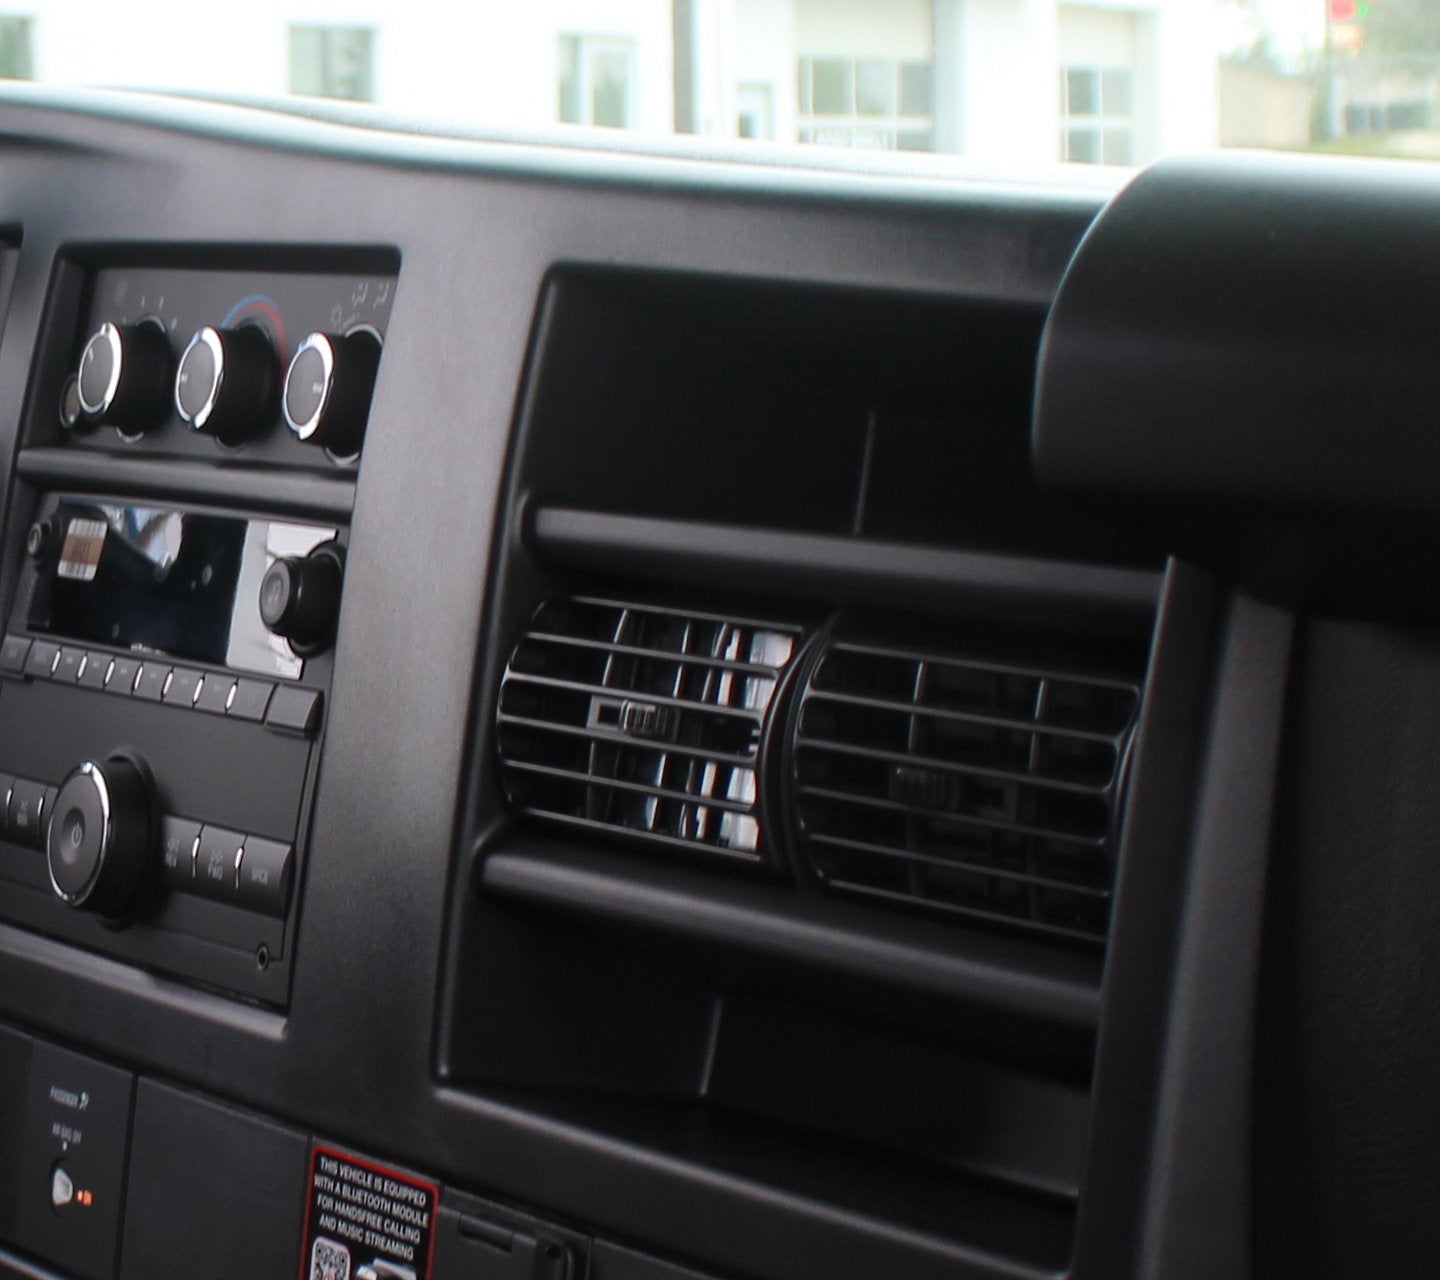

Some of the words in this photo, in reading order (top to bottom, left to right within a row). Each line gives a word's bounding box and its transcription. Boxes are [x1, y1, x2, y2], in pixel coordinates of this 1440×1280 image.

[314, 1174, 333, 1192] WITH
[335, 1181, 341, 1195] A
[342, 1183, 391, 1213] BLUETOOTH
[392, 1202, 429, 1228] MODULE
[320, 1156, 338, 1176] THIS
[339, 1163, 372, 1188] VEHICLE
[374, 1176, 382, 1192] IS
[384, 1180, 426, 1207] EQUIPPED
[317, 1193, 333, 1210] FOR
[335, 1200, 382, 1230] HANDSFREE
[384, 1218, 421, 1245] CALLING
[319, 1214, 337, 1231] AND
[338, 1220, 364, 1242] MUSIC
[365, 1231, 414, 1261] STREAMING
